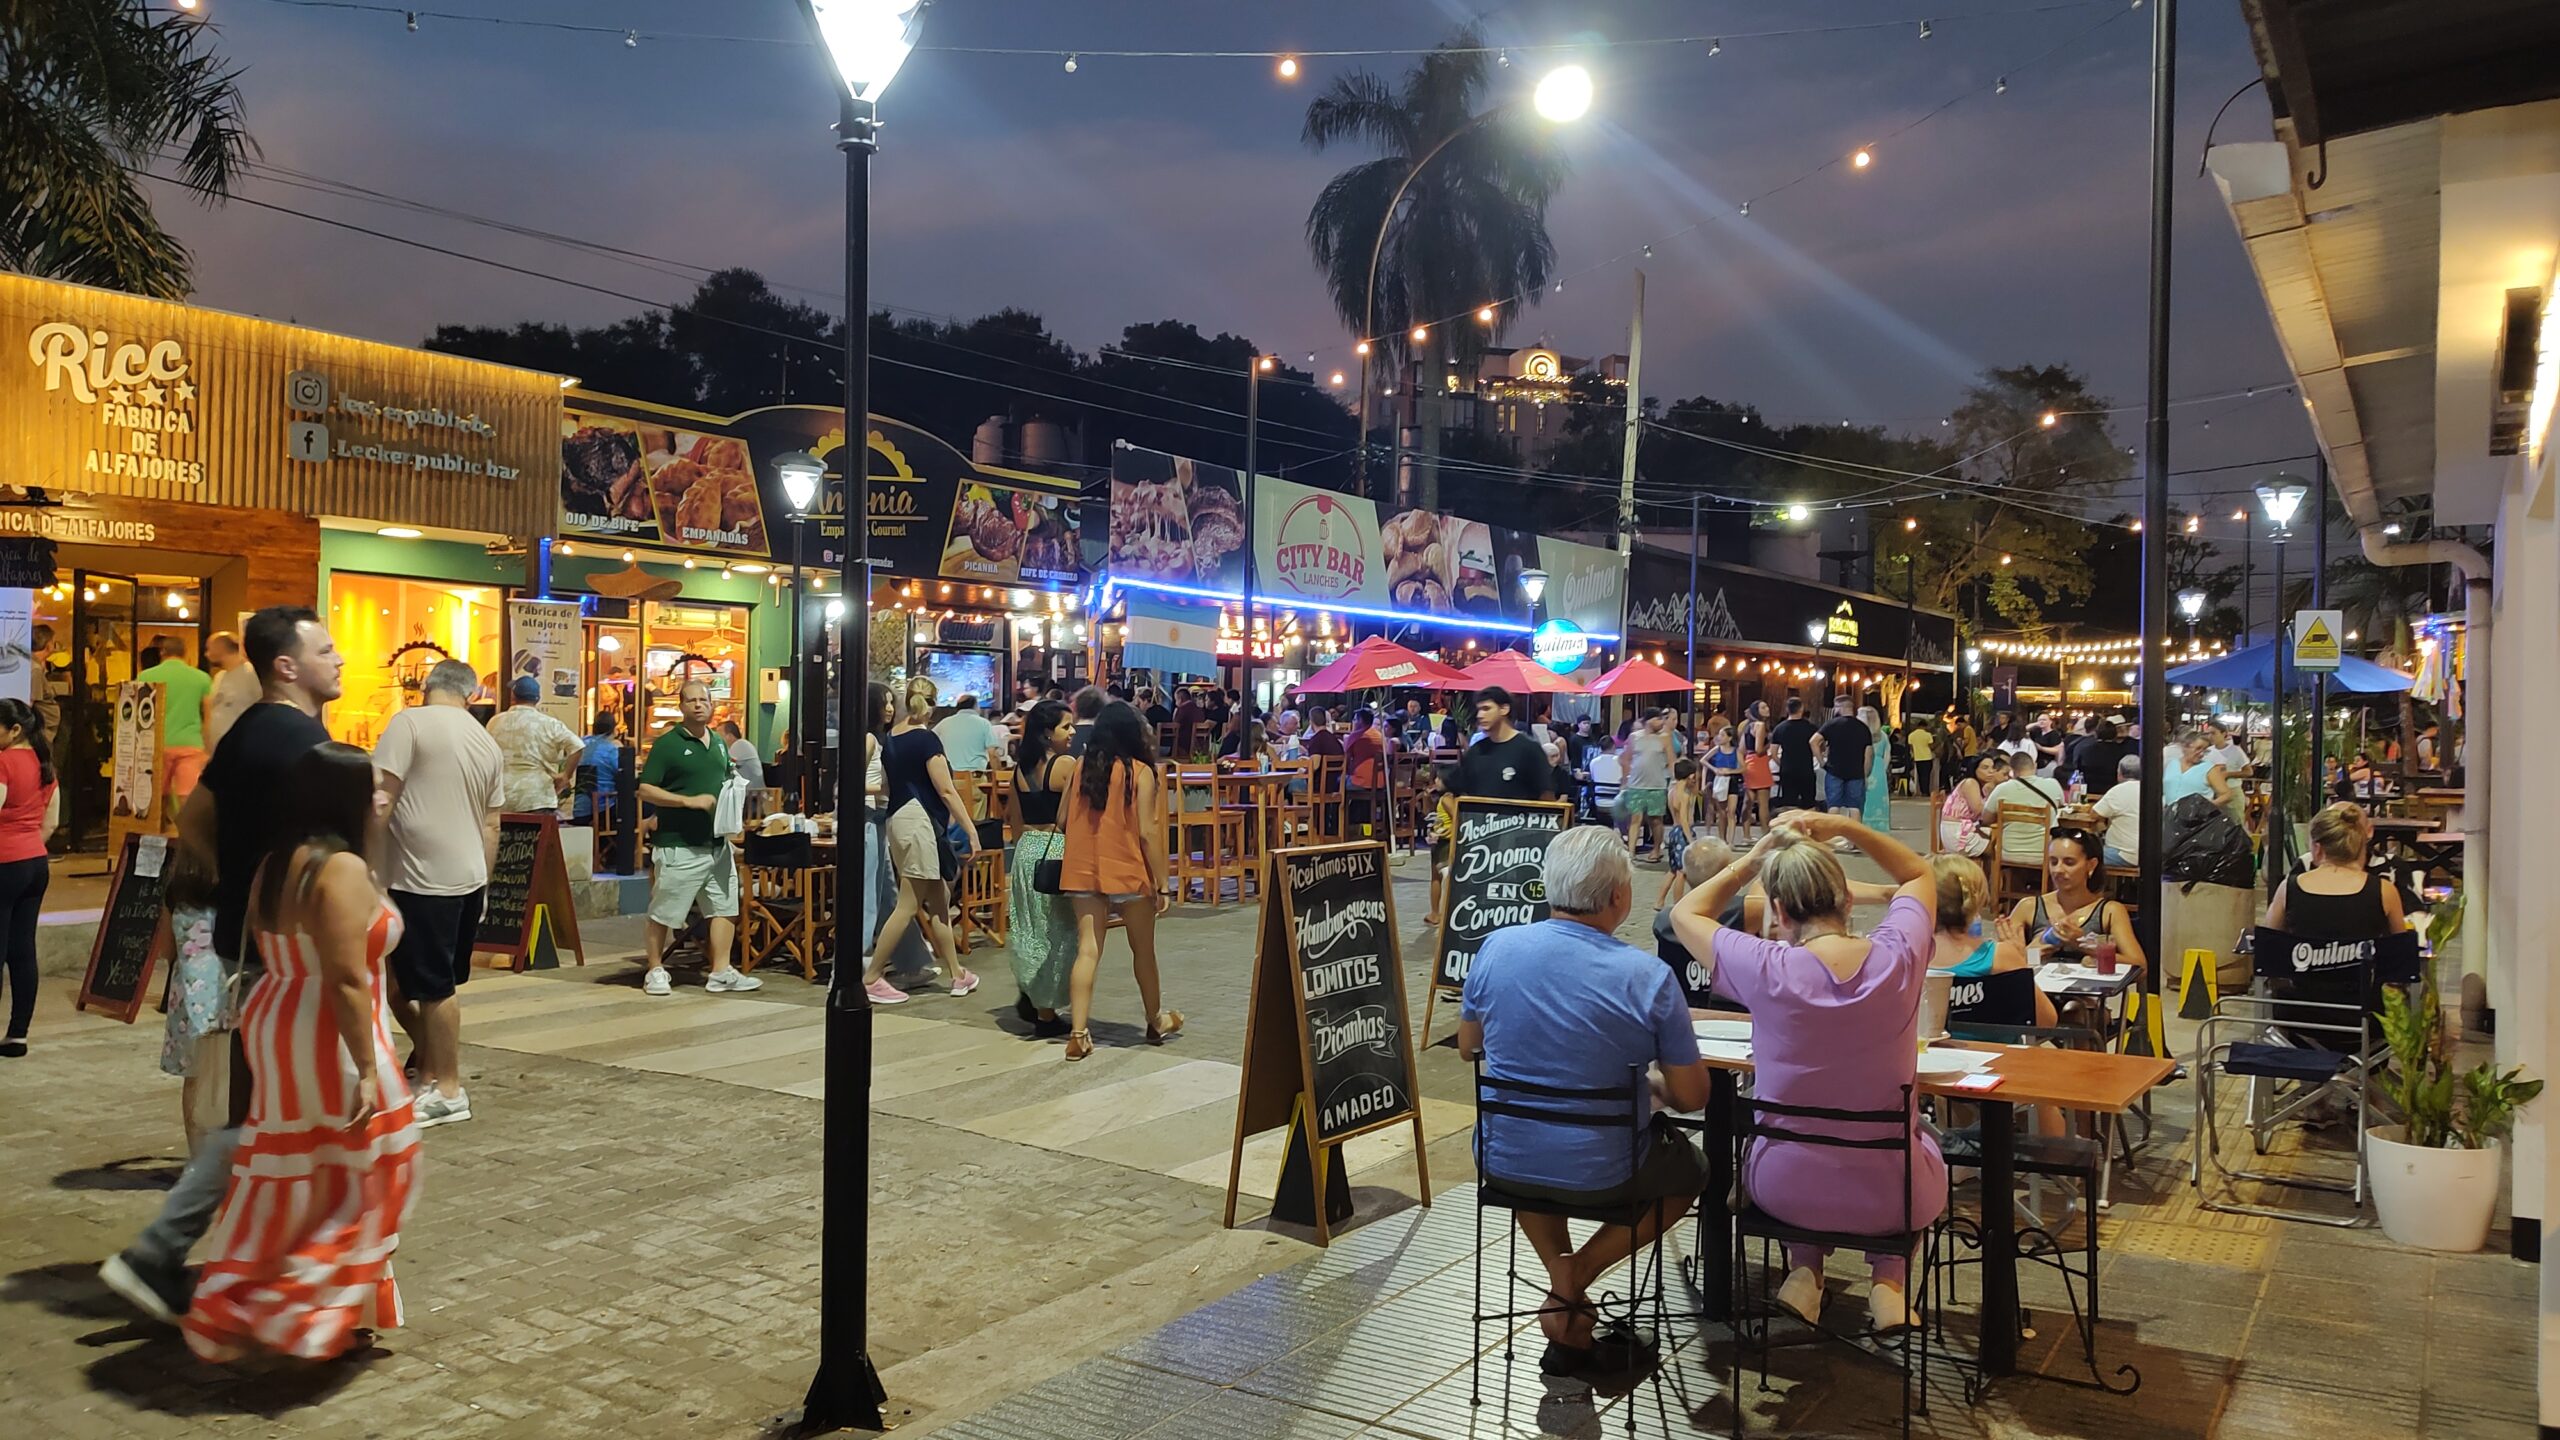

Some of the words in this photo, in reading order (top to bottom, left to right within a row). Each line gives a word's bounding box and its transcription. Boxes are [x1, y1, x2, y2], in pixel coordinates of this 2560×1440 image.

[102, 403, 191, 434] FABRICA
[131, 431, 157, 454] DE
[85, 449, 200, 484] ALFAJORES
[415, 453, 482, 475] public
[486, 459, 520, 480] bar
[40, 515, 61, 534] DE
[66, 518, 155, 542] ALFAJORES
[565, 512, 587, 526] OJO
[591, 515, 608, 529] DE
[611, 518, 640, 532] BIFE
[871, 521, 906, 536] Gourmet
[682, 527, 749, 545] EMPANADAS
[964, 561, 998, 574] PICANHA
[1276, 543, 1323, 574] CITY
[1326, 546, 1365, 586] BAR
[1303, 572, 1339, 588] LANCHES
[1562, 564, 1617, 612] Quilmes
[518, 605, 557, 618] Fábrica
[560, 608, 572, 618] de
[522, 618, 568, 630] alfajores
[1527, 813, 1559, 829] PIX
[1347, 854, 1374, 878] PIX
[1455, 844, 1545, 882] Promo
[1487, 883, 1516, 899] EN
[1302, 956, 1380, 999] LOMITOS
[1315, 1011, 1385, 1061] Picanhas
[1324, 1085, 1394, 1131] AMADEO
